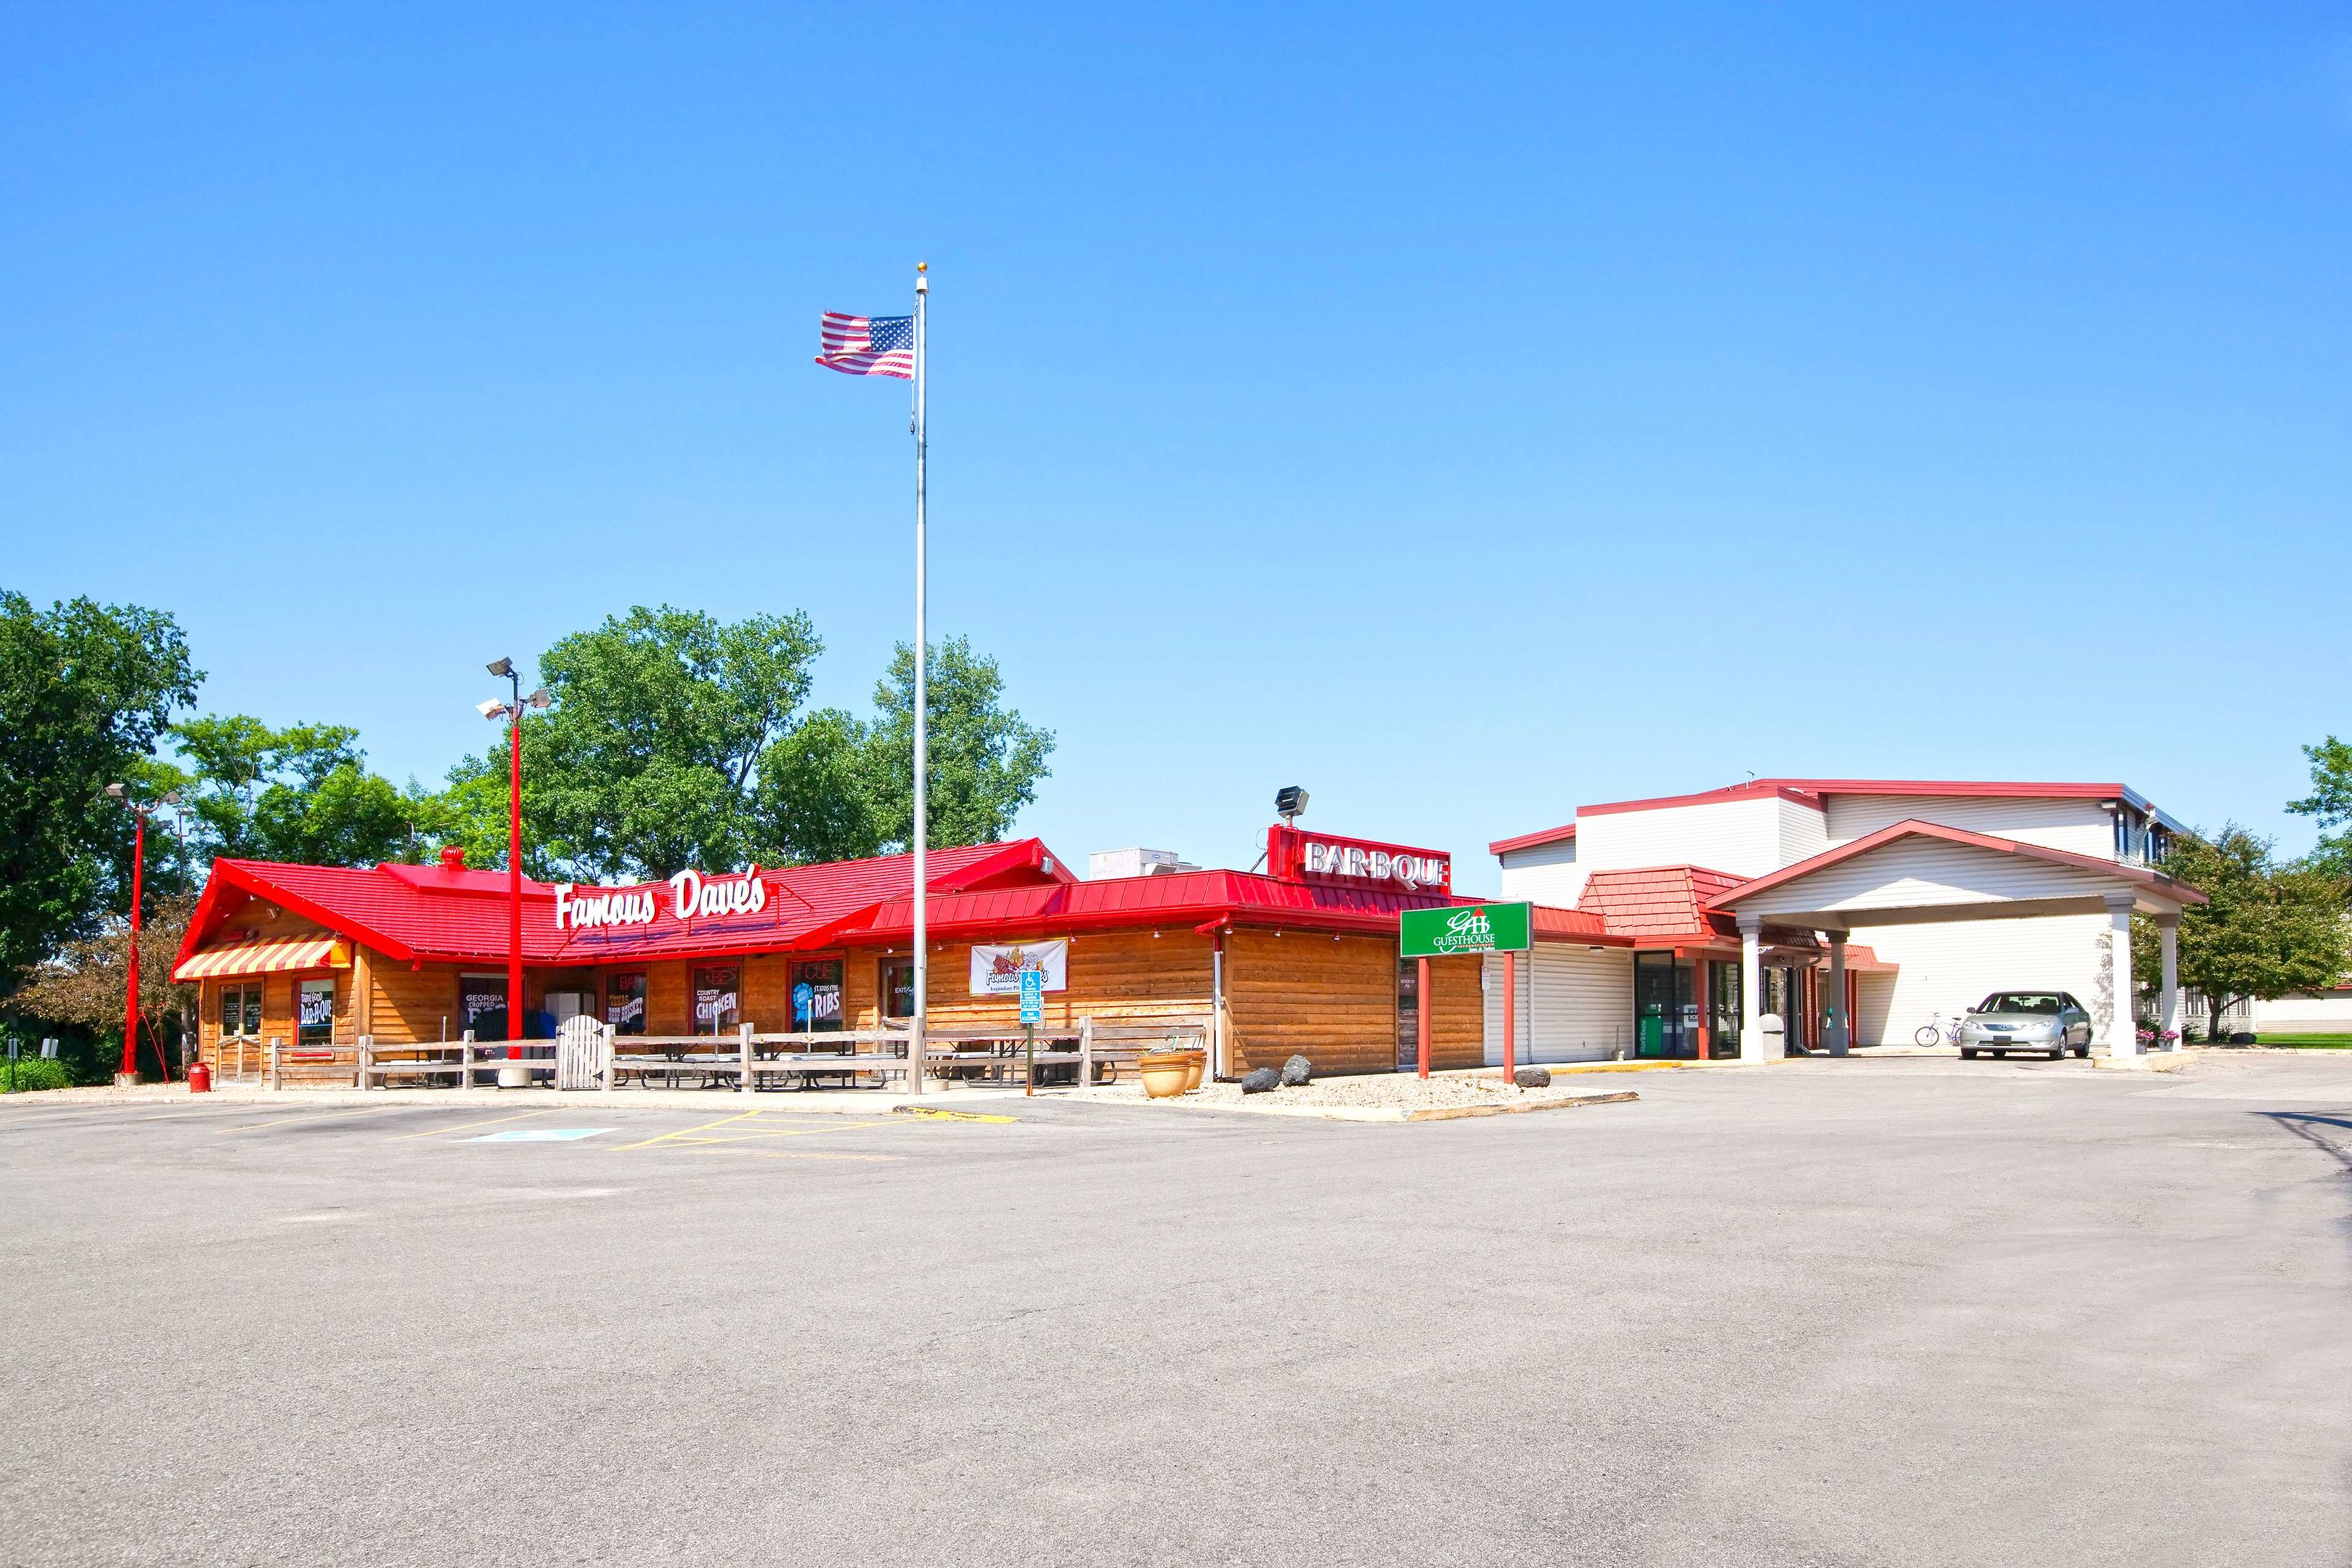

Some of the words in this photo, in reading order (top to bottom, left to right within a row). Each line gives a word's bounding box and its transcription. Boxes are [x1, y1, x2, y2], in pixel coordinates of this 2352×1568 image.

[555, 883, 656, 930] Famous
[669, 863, 766, 920] Dave's
[986, 969, 1020, 986] Famous
[608, 1006, 621, 1024] BEEF
[621, 997, 643, 1024] BRISKET
[609, 995, 629, 1007] TEXAS
[696, 992, 736, 1019] CHICKEN
[814, 991, 840, 1018] RIBS
